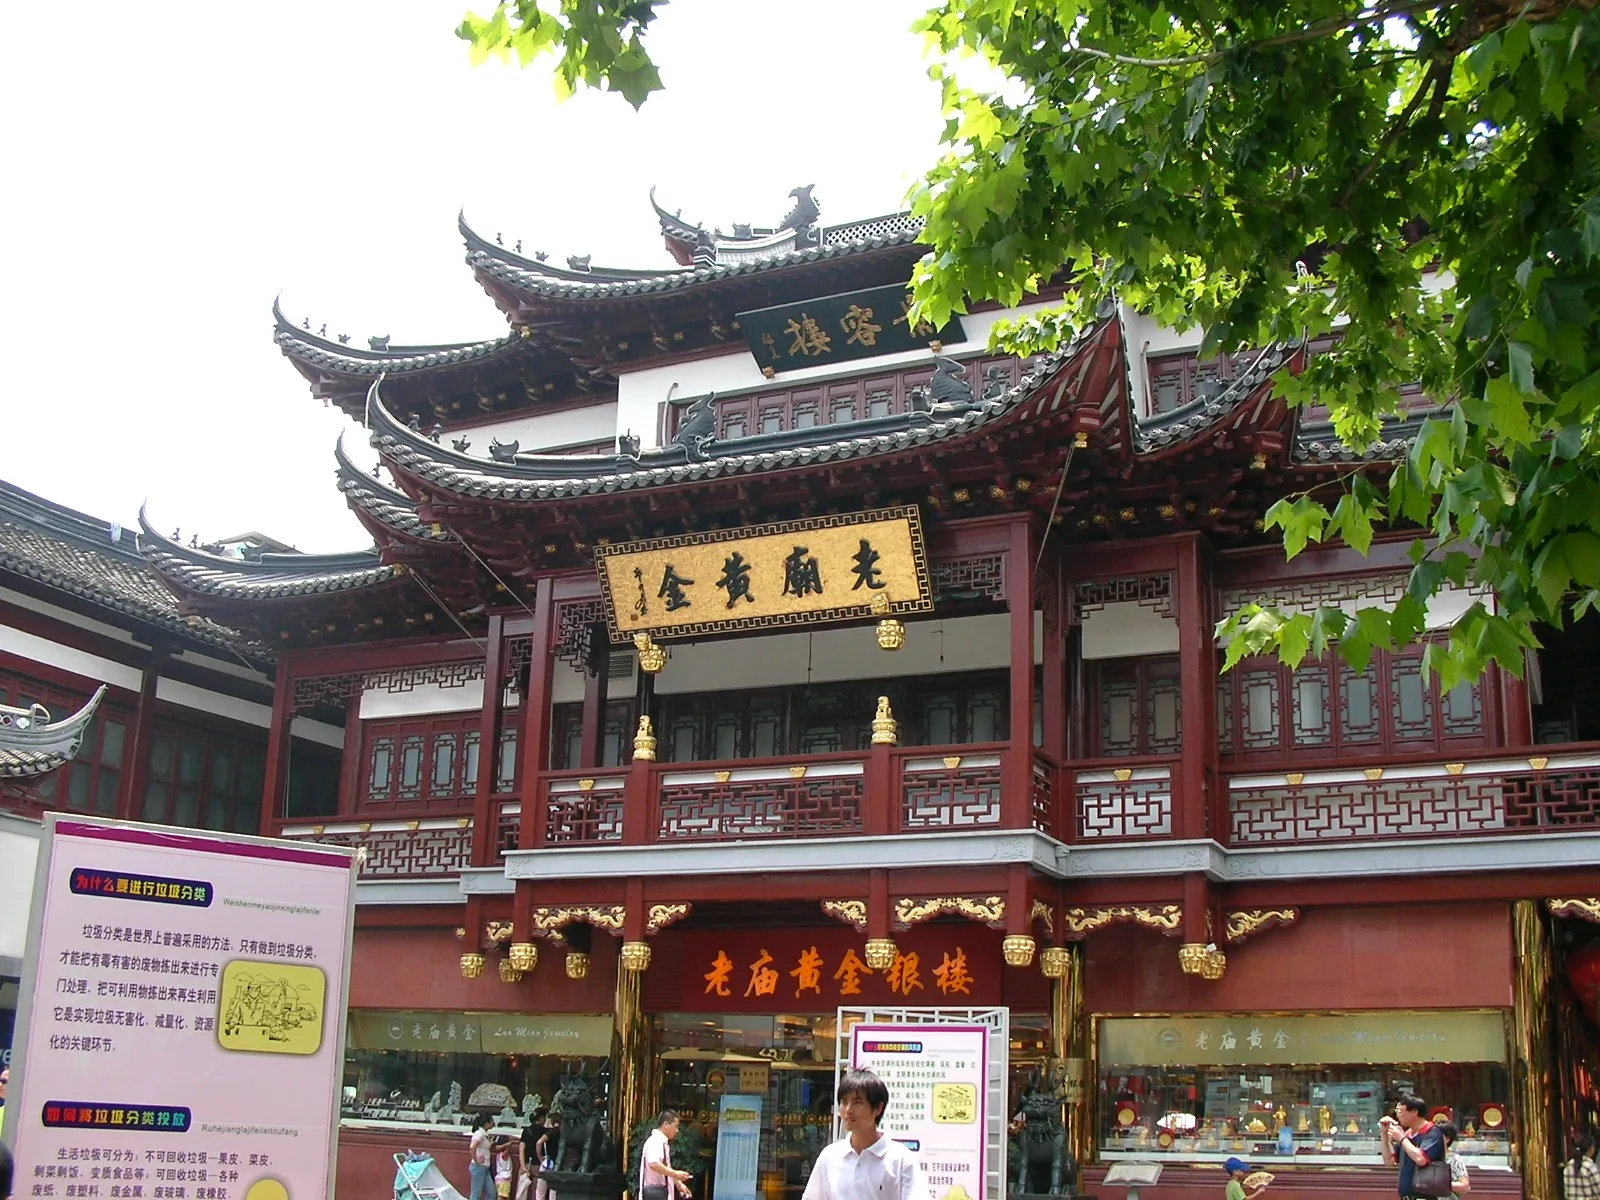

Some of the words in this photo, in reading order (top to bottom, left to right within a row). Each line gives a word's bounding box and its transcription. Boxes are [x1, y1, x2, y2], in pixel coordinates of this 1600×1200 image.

[76, 874, 206, 901] 为什么要进行垃圾分类
[59, 950, 219, 978] 才能把有毒有害的废物拣出来进行专
[703, 946, 975, 999] 老庙黄金银楼
[411, 1023, 476, 1041] 老庙黄金
[494, 1026, 512, 1037] Lao
[543, 1027, 580, 1039] Jewelry
[1195, 1028, 1292, 1050] 老庙黄金
[47, 1107, 185, 1127] 如何将垃圾分类投放
